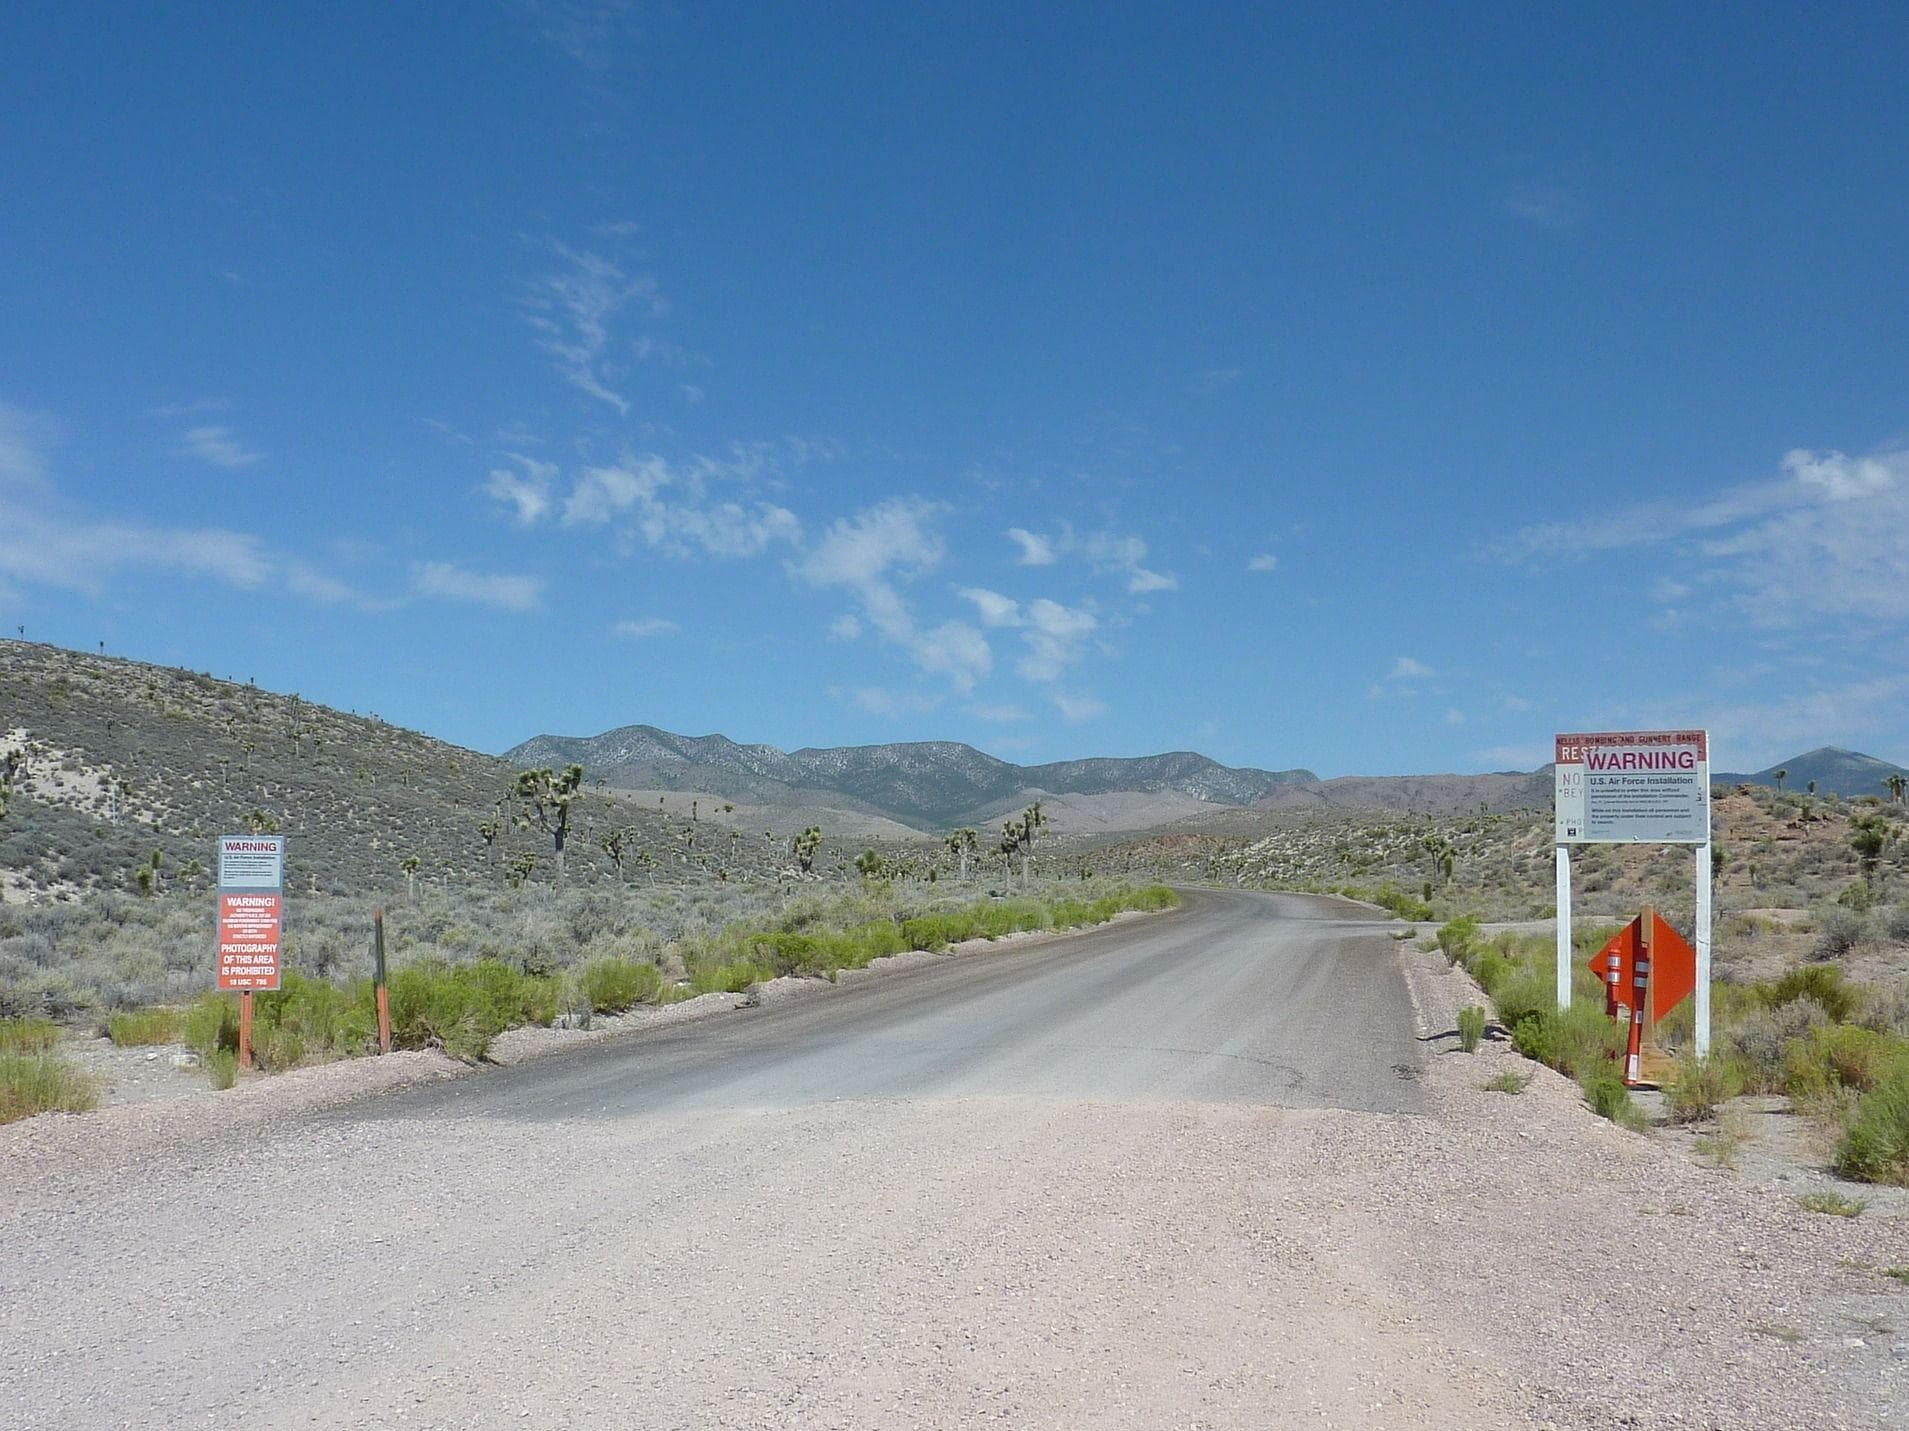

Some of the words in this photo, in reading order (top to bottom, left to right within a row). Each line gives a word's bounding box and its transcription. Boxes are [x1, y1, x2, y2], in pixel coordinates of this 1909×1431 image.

[1586, 736, 1618, 744] BOMBING
[1620, 736, 1634, 744] AND
[1639, 735, 1671, 743] GUNNERY
[1676, 734, 1701, 742] RANGE
[1586, 752, 1694, 770] WARNING
[1563, 773, 1580, 786] NO
[225, 842, 276, 851] WARNING
[227, 898, 275, 906] WARNING!
[221, 944, 277, 953] PHOTOGRAPHY
[224, 955, 234, 964] OF
[236, 955, 252, 964] THIS
[253, 955, 274, 964] AREA
[222, 967, 229, 975] IS
[231, 967, 275, 975] PROHIBITED
